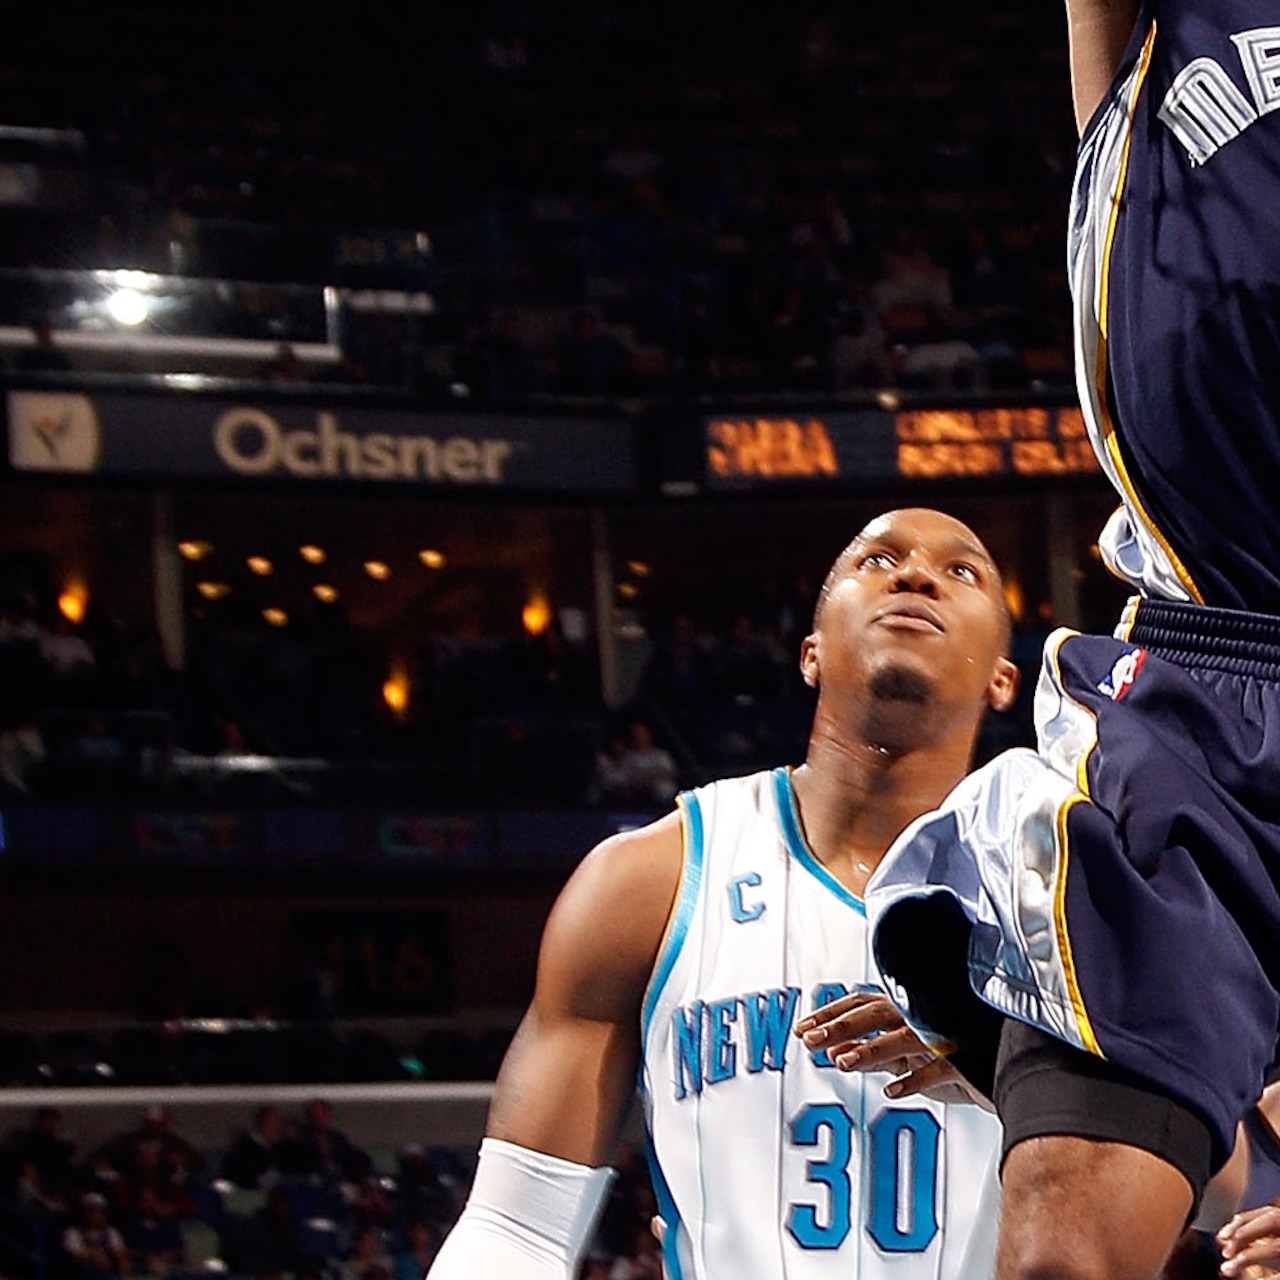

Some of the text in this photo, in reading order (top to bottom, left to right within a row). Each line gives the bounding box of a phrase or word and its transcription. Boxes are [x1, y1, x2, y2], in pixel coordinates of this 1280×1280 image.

[214, 406, 510, 481] Ochsner
[727, 871, 767, 923] C
[672, 986, 802, 1101] NEW
[787, 1103, 942, 1253] 30
